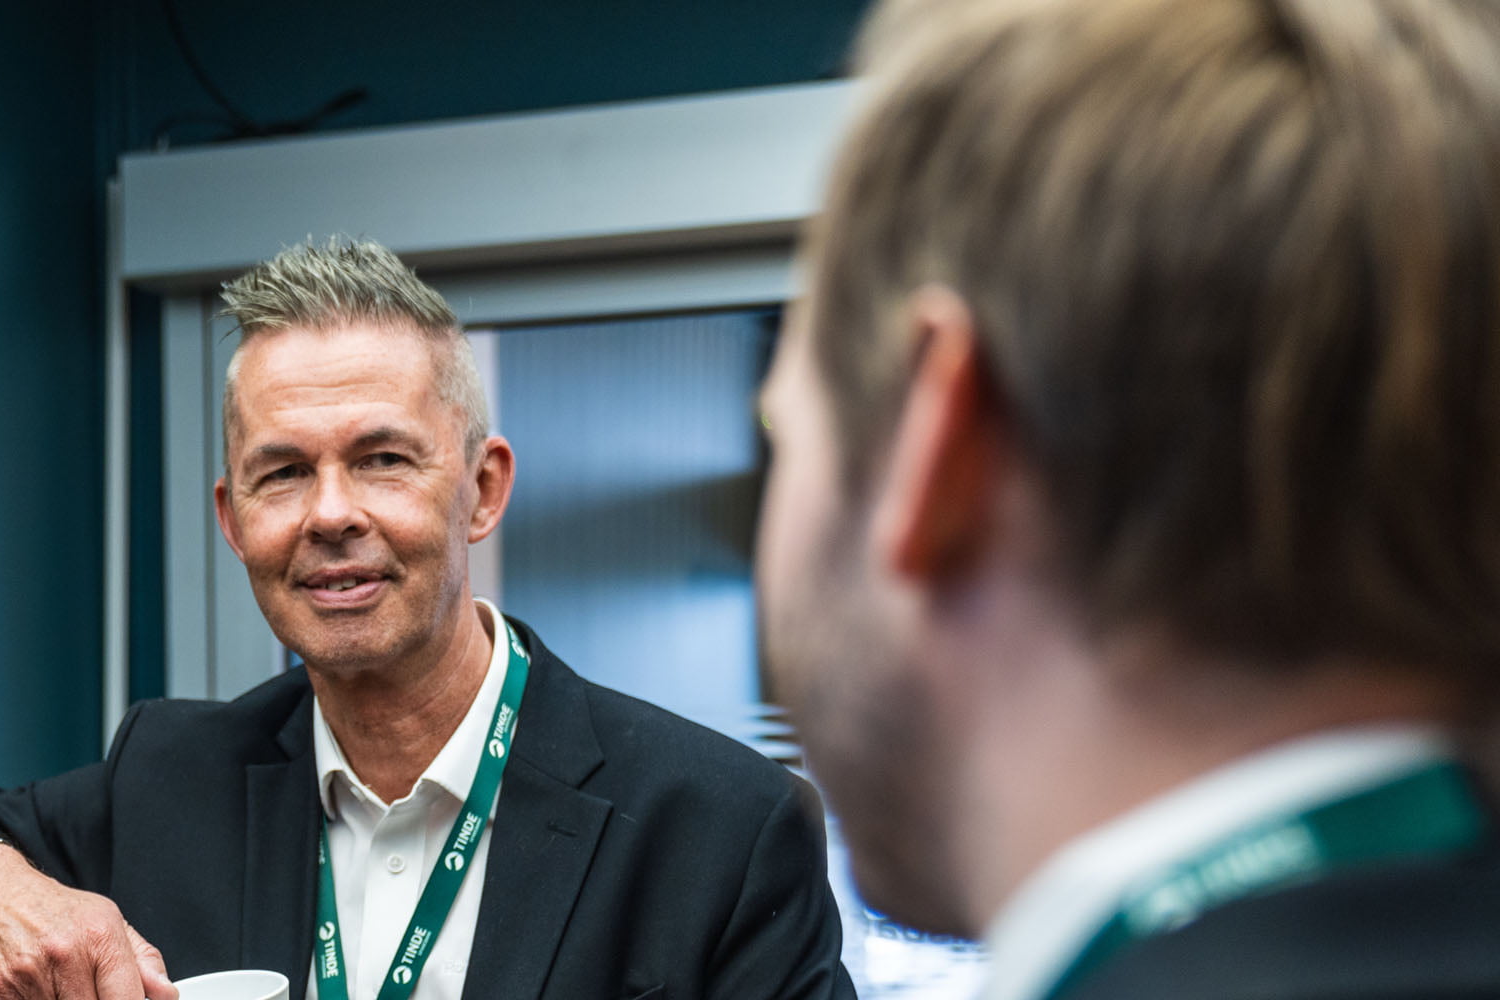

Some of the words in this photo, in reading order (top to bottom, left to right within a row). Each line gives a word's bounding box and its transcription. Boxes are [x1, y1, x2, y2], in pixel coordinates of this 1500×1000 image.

[493, 702, 511, 740] TINDE
[453, 811, 479, 851] TINDE
[323, 940, 339, 978] TINDE
[401, 926, 428, 965] TINDE
